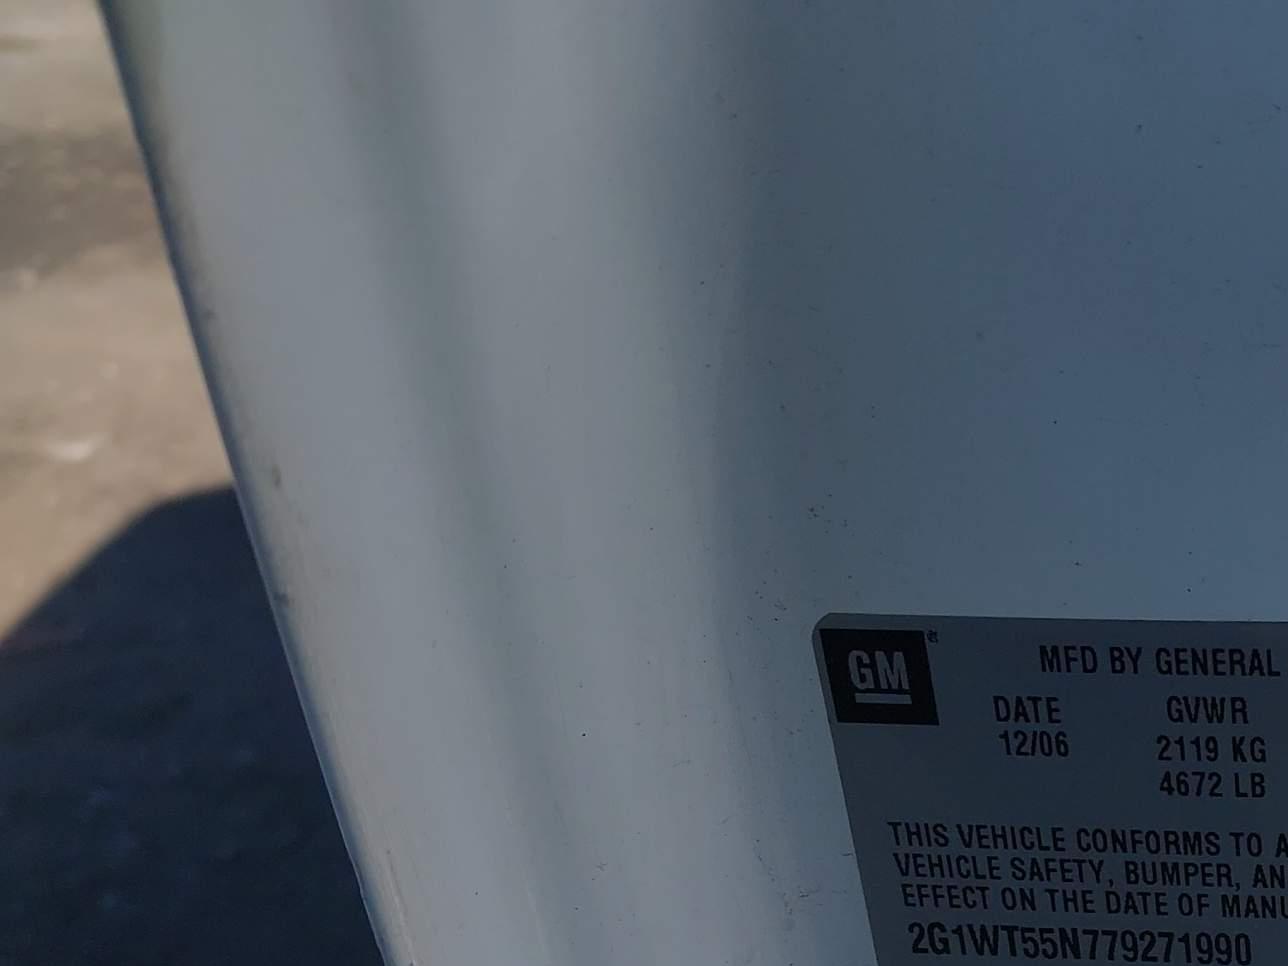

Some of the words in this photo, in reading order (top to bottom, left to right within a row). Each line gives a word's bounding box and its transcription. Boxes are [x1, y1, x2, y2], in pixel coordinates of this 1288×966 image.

[848, 650, 911, 690] GM
[1039, 645, 1098, 673] MFD
[1111, 646, 1142, 674] BY
[1155, 647, 1281, 677] GENERAL
[993, 696, 1061, 724] DATE
[1166, 696, 1248, 724] GVWR
[999, 728, 1069, 757] 12/06
[1156, 735, 1219, 762] 2119
[1232, 736, 1266, 763] KG
[1160, 770, 1223, 797] 4672
[1233, 772, 1265, 798] LB
[888, 822, 948, 848] THIS
[957, 824, 1065, 851] VEHICLE
[1077, 828, 1220, 855] CONFORMS
[1230, 831, 1263, 857] TO
[894, 853, 1002, 880] VEHICLE
[1010, 857, 1114, 887] SAFETY,
[1125, 861, 1241, 891] BUMPER,
[901, 883, 990, 910] EFFECT
[1001, 886, 1036, 911] ON
[1046, 888, 1096, 914] THE
[1104, 888, 1168, 916] DATE
[1177, 892, 1212, 917] OF
[908, 920, 1251, 966] 2G1WT55N779271990
